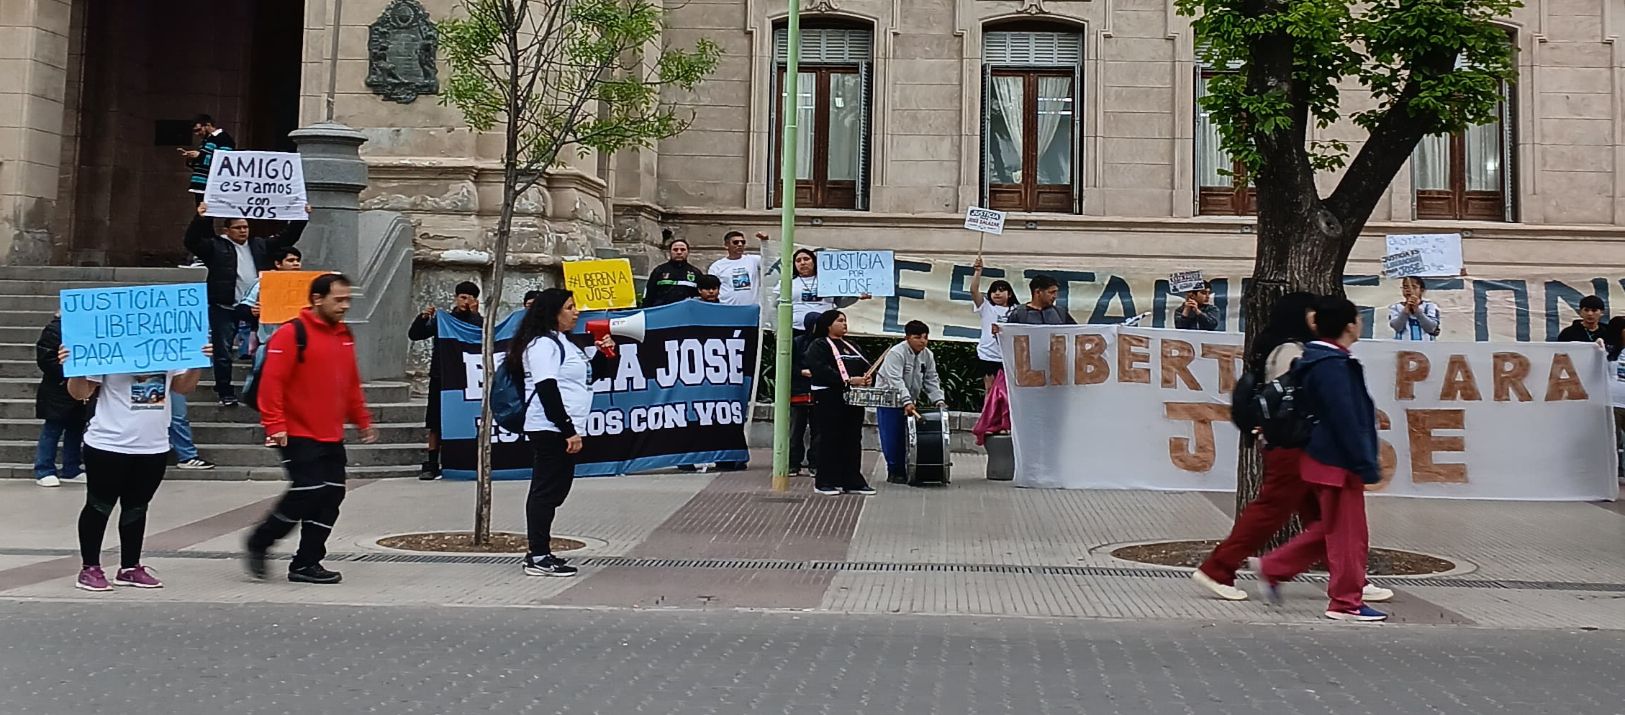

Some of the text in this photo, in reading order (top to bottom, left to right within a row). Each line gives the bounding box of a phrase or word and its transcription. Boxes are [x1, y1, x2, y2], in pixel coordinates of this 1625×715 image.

[217, 156, 293, 180] AMIGO
[238, 206, 277, 218] VOS
[247, 197, 270, 206] con
[823, 252, 884, 270] JUSTICIA
[618, 270, 629, 284] A
[839, 278, 872, 294] JOSE
[64, 288, 200, 313] JUSTICIA ES
[586, 286, 617, 301] JOSE
[95, 308, 203, 339] LIBERACION
[72, 337, 193, 369] PARA JOSE
[656, 329, 746, 388] JOSÉ
[1013, 333, 1589, 402] LIBERT PARA
[630, 403, 688, 432] CON
[694, 401, 743, 426] VOS
